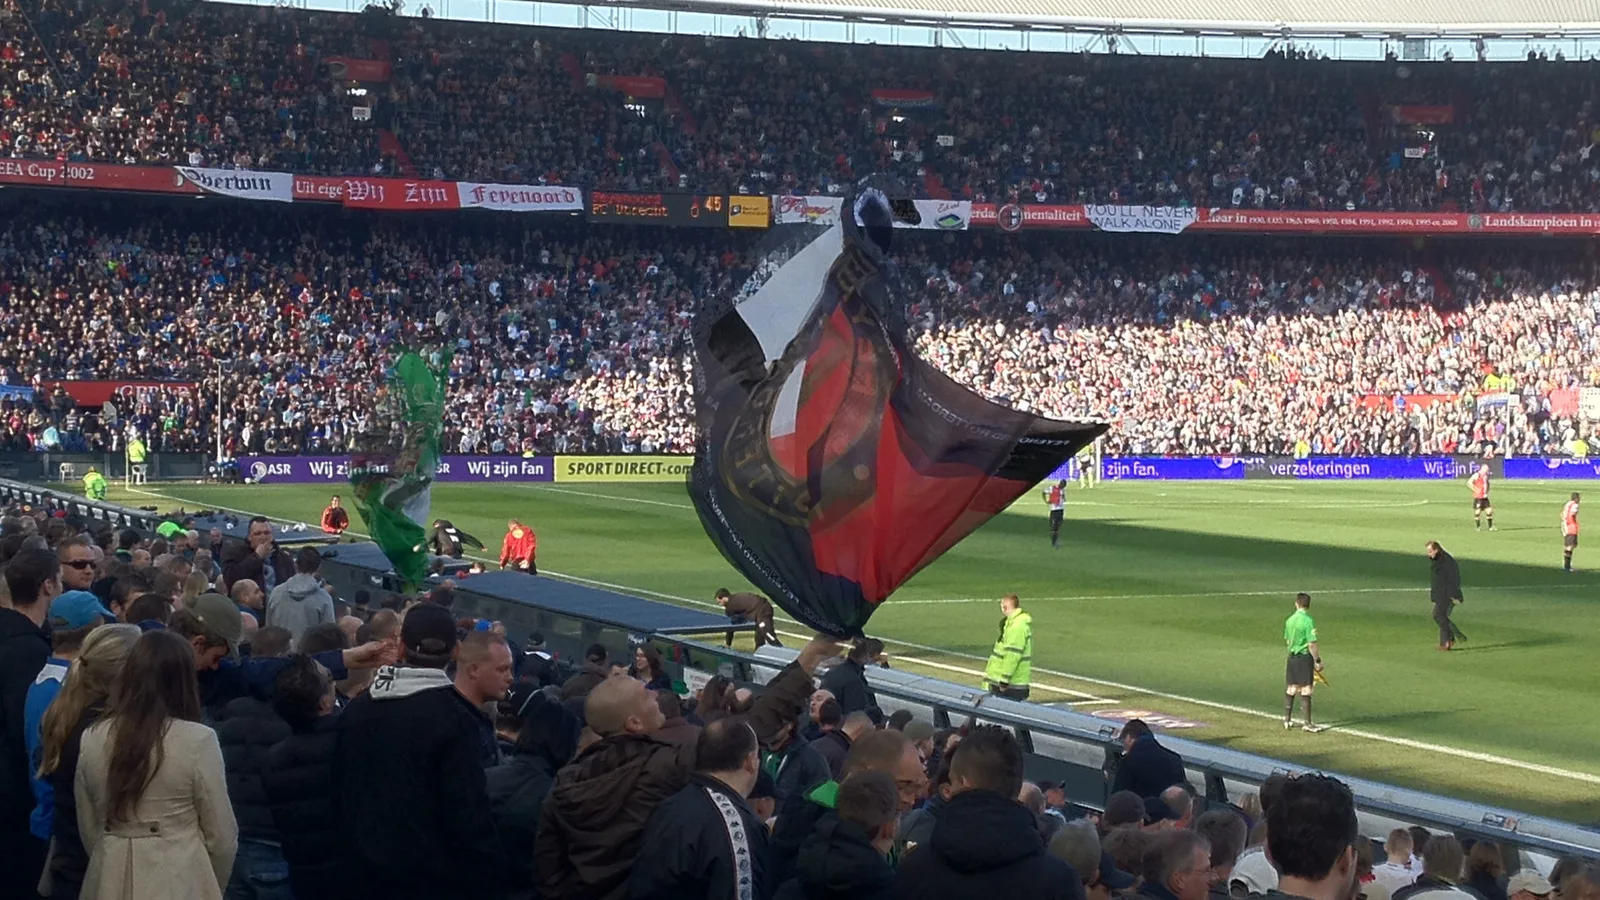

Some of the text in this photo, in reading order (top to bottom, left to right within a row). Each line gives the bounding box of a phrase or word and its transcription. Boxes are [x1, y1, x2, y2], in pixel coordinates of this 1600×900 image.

[28, 163, 56, 181] Cup
[296, 180, 315, 193] Uit
[467, 186, 576, 205] Feyenoord
[705, 196, 722, 211] 45
[1143, 206, 1193, 218] NEVER
[1236, 213, 1247, 223] in
[1135, 219, 1181, 231] ALONE
[1485, 216, 1577, 230] Landskampioen
[1580, 216, 1592, 227] in
[267, 463, 291, 475] ASR
[309, 461, 334, 478] Wij
[467, 461, 544, 479] Wij zijn fan
[1107, 463, 1130, 480] zijn
[1269, 461, 1370, 478] verzekeringen
[1423, 461, 1444, 478] Wij
